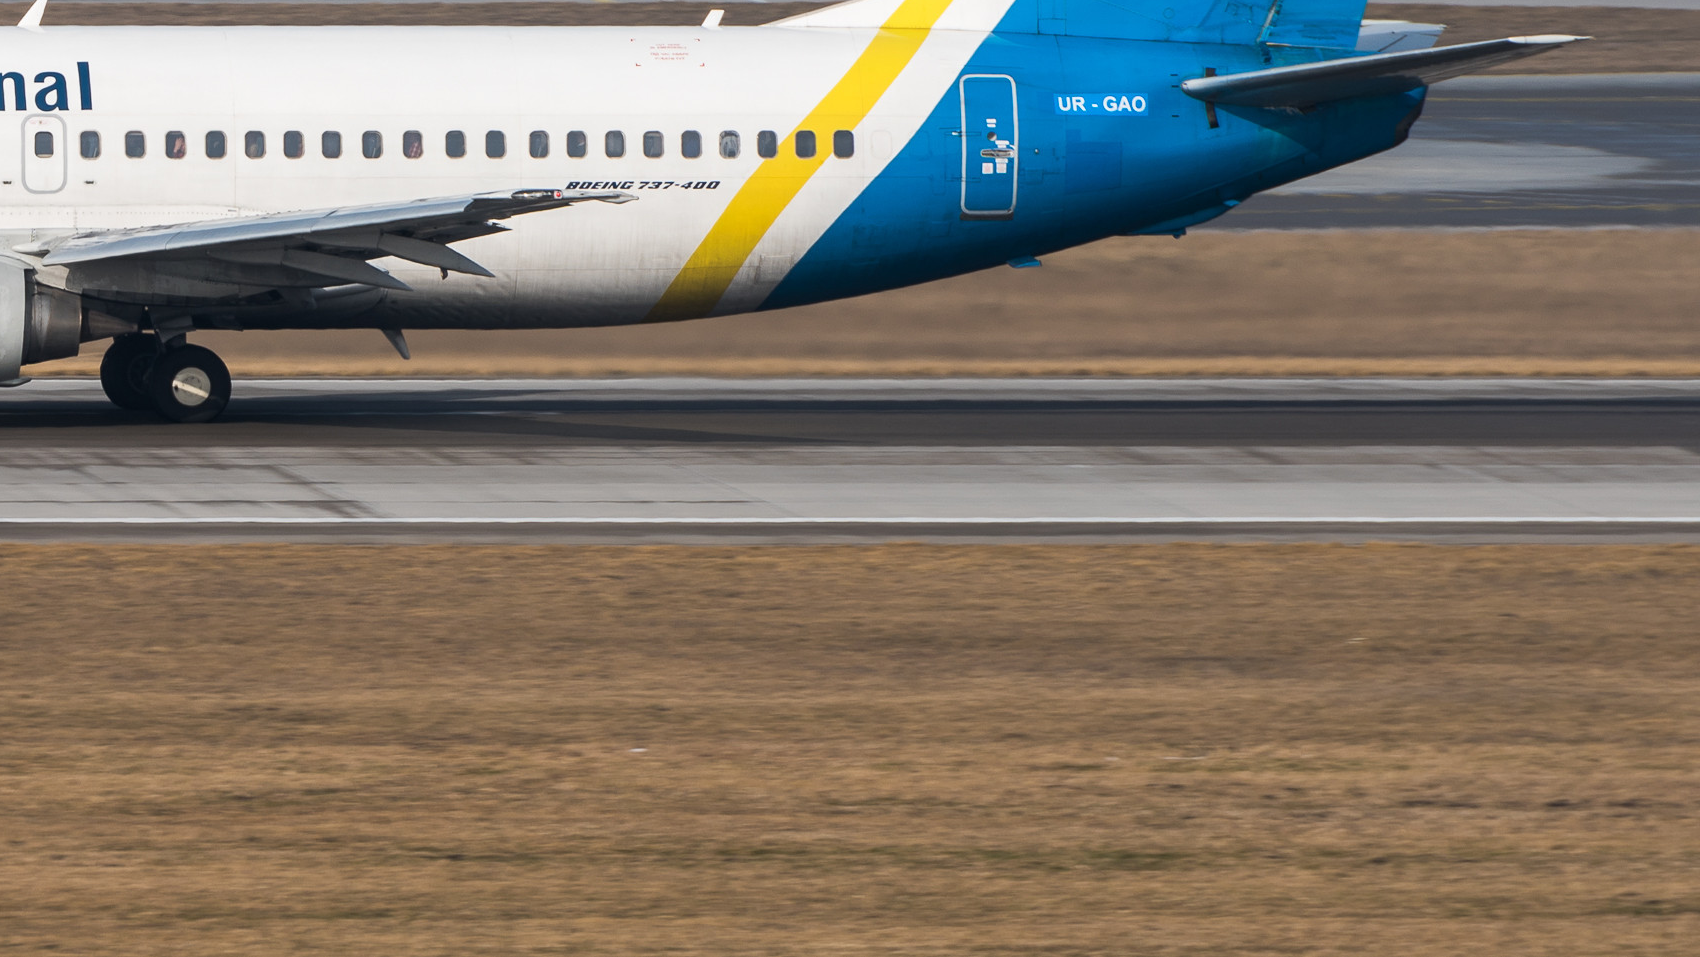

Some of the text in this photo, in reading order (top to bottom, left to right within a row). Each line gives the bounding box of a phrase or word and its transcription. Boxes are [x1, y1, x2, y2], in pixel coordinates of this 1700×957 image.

[1057, 96, 1087, 112] UR
[1102, 95, 1147, 113] GAO
[565, 181, 721, 190] BOEING 737-400
